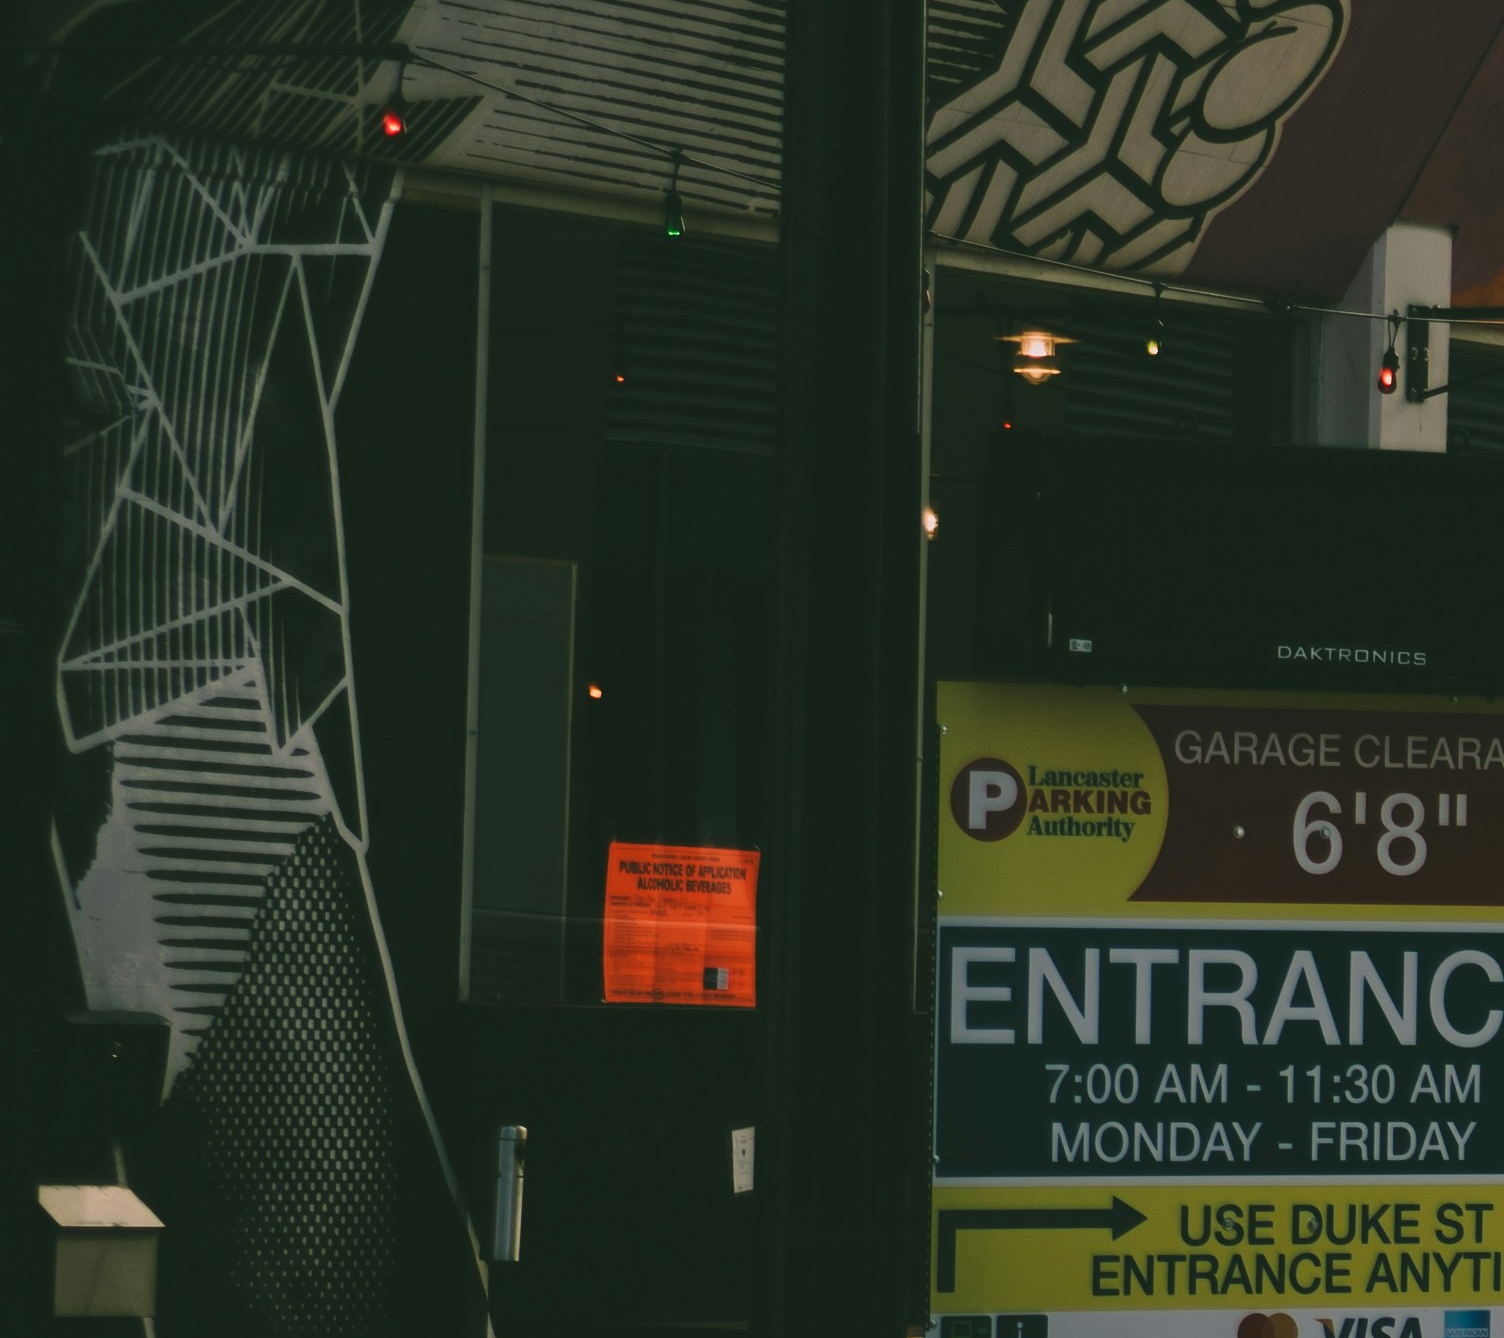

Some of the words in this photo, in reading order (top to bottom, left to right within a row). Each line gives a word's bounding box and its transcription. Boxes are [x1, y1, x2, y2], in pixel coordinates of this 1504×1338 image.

[1278, 645, 1427, 666] DAKTRONICS
[1175, 731, 1341, 767] GARAGE
[1028, 766, 1143, 788] Lancaster
[1027, 816, 1135, 843] Authority
[1292, 791, 1468, 876] 6'8"
[619, 860, 652, 875] PUBLIC
[653, 862, 684, 877] NOTICE
[686, 864, 696, 878] OF
[698, 865, 747, 880] APPLICATION
[1045, 1065, 1139, 1105] 7:00
[1154, 1064, 1228, 1104] AM
[1279, 1064, 1395, 1104] 11:30
[1411, 1064, 1482, 1103] AM
[1052, 1122, 1263, 1163] MONDAY
[1311, 1122, 1476, 1162] FRIDAY
[1179, 1205, 1275, 1247] USE
[1292, 1204, 1419, 1245] DUKE
[1435, 1203, 1493, 1244] ST
[1092, 1253, 1351, 1297] ENTRANCE
[1445, 1328, 1489, 1338] AMERICAN
